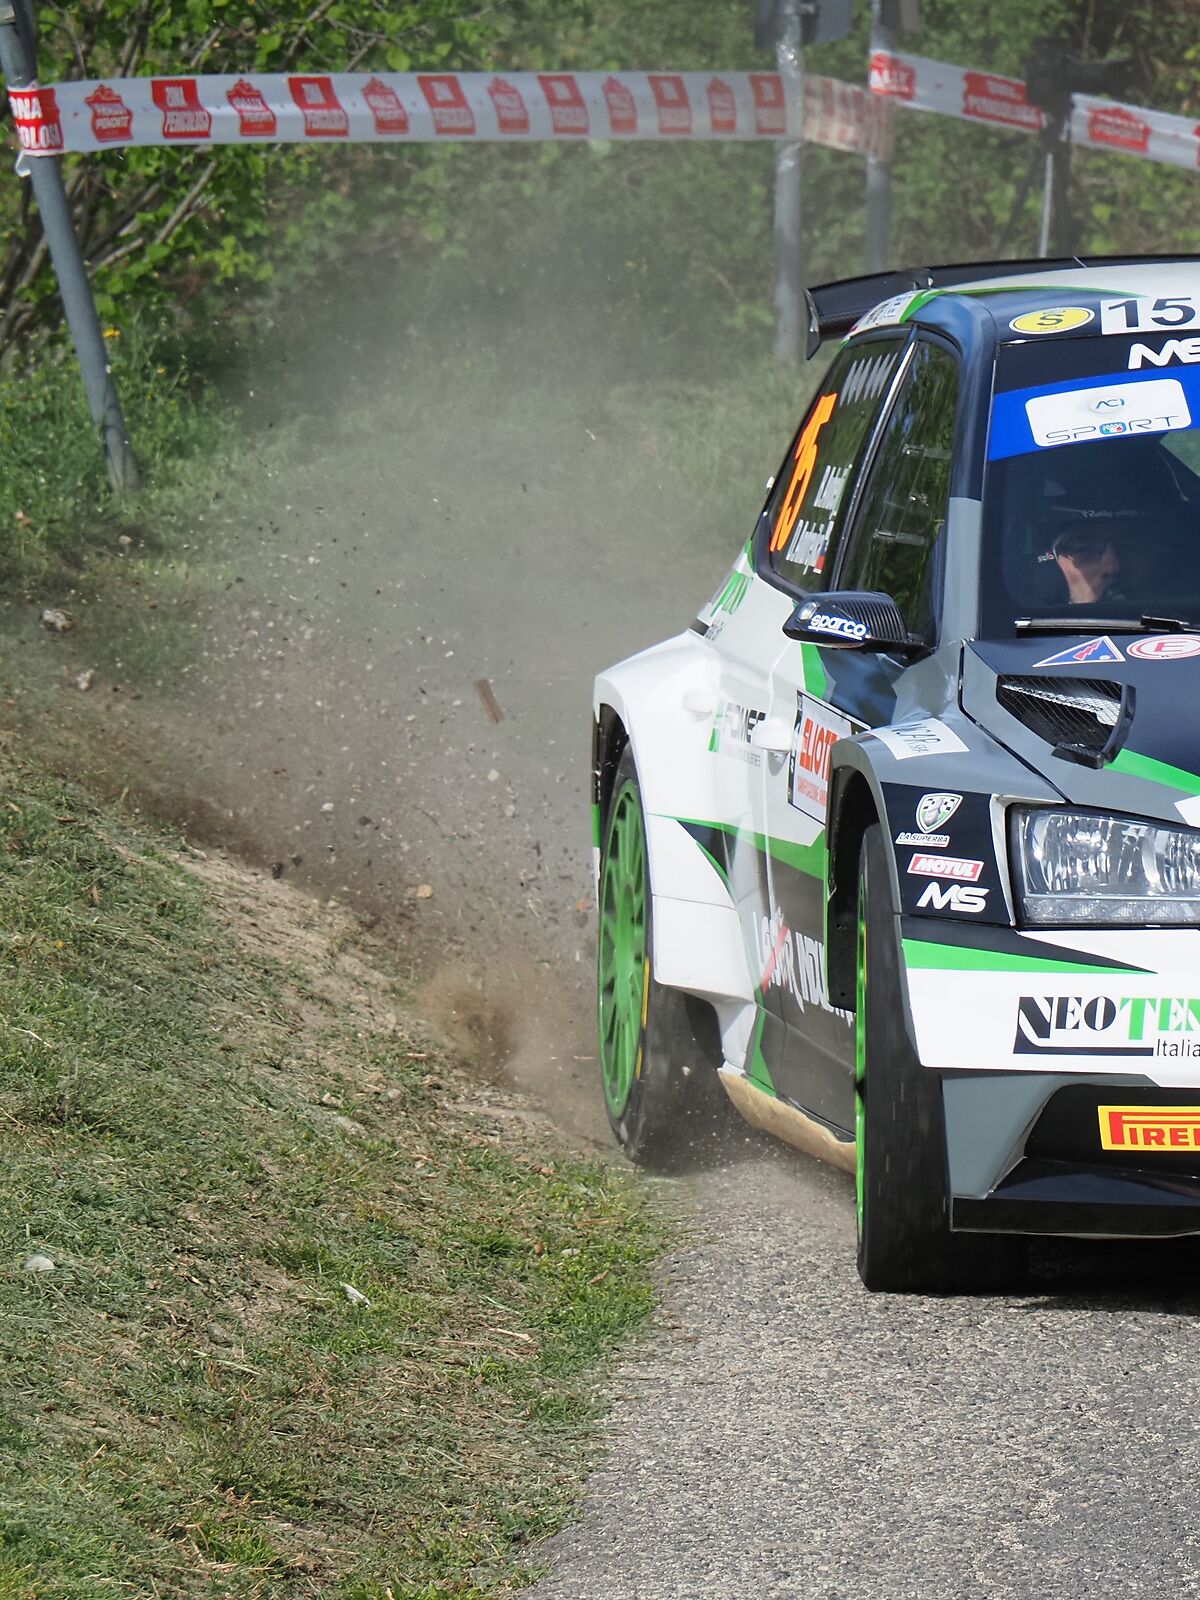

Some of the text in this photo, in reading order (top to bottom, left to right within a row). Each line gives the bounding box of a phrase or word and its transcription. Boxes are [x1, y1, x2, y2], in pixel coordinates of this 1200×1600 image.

[1108, 297, 1196, 328] 15
[802, 612, 869, 640] sparco
[915, 857, 975, 877] MOTUL
[916, 881, 990, 913] MS
